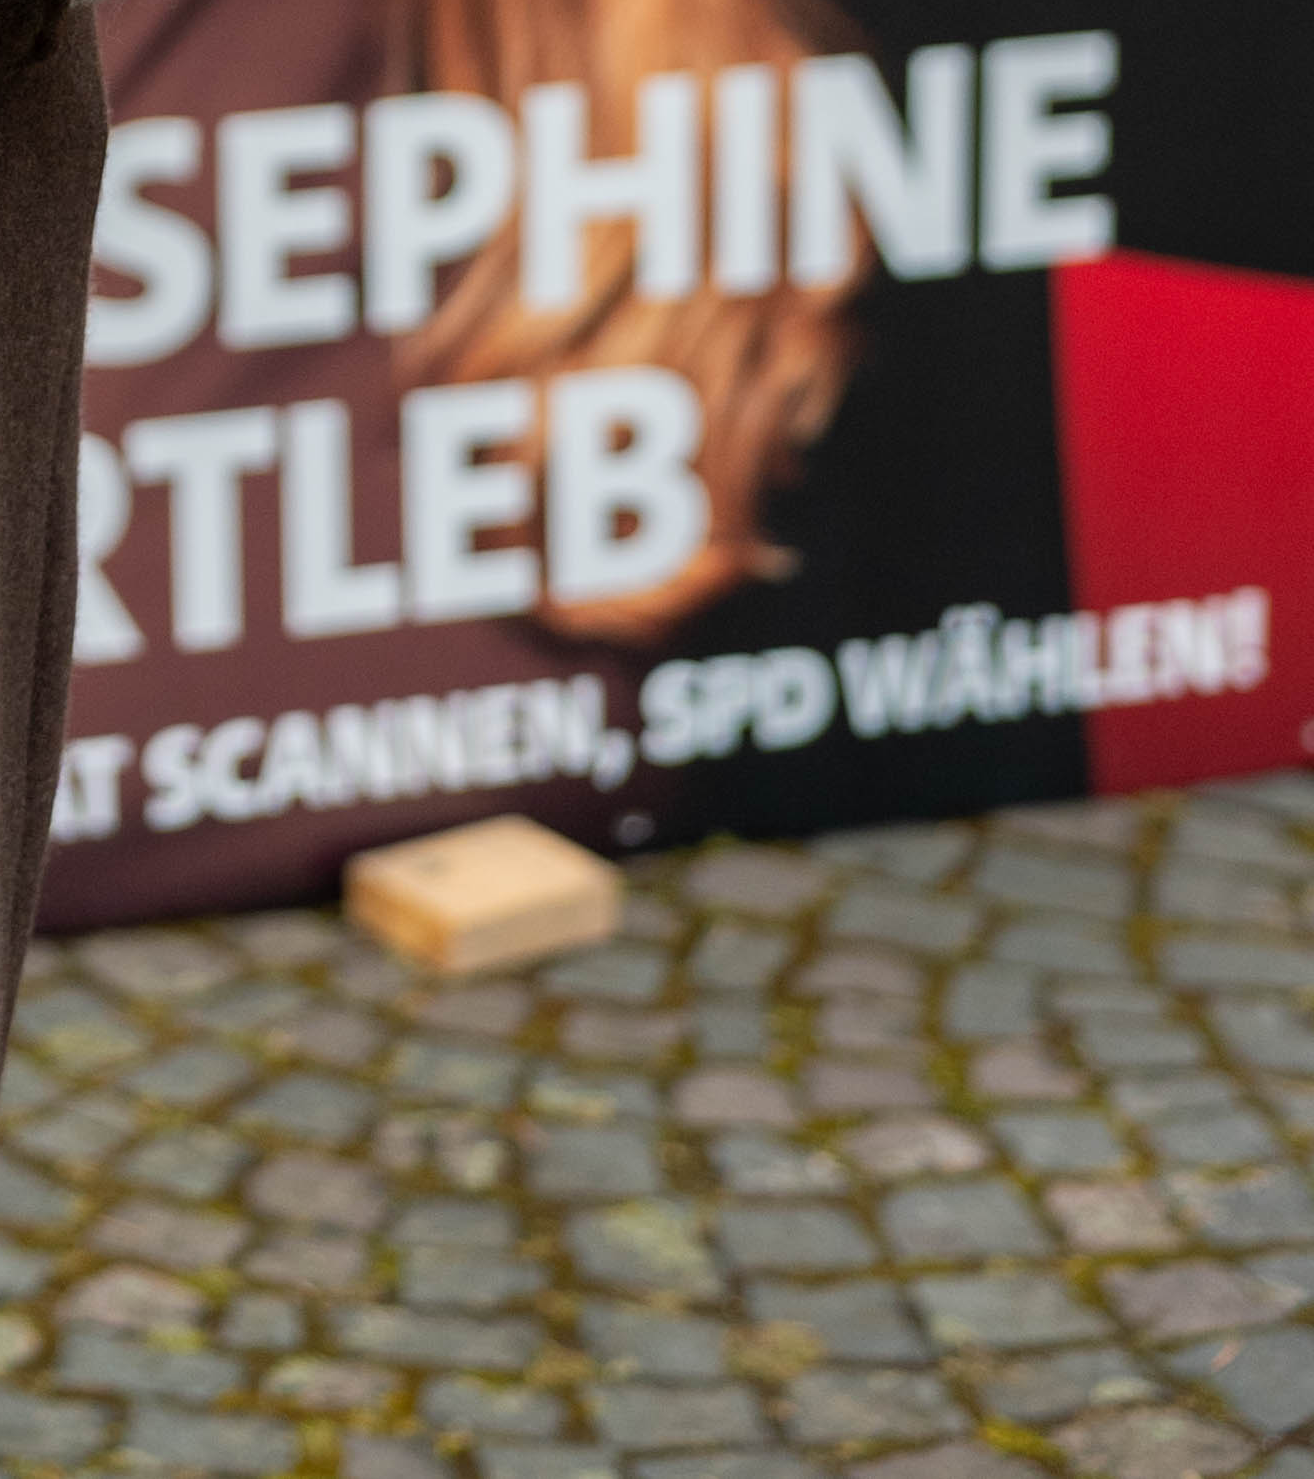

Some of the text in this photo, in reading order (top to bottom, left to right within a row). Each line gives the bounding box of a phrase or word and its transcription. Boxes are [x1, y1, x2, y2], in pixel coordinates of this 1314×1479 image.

[83, 29, 1120, 367] SEPHINE
[141, 672, 636, 832] SCANNEN,
[639, 644, 838, 766] SPD
[836, 584, 1271, 740] WÄHLEN!
